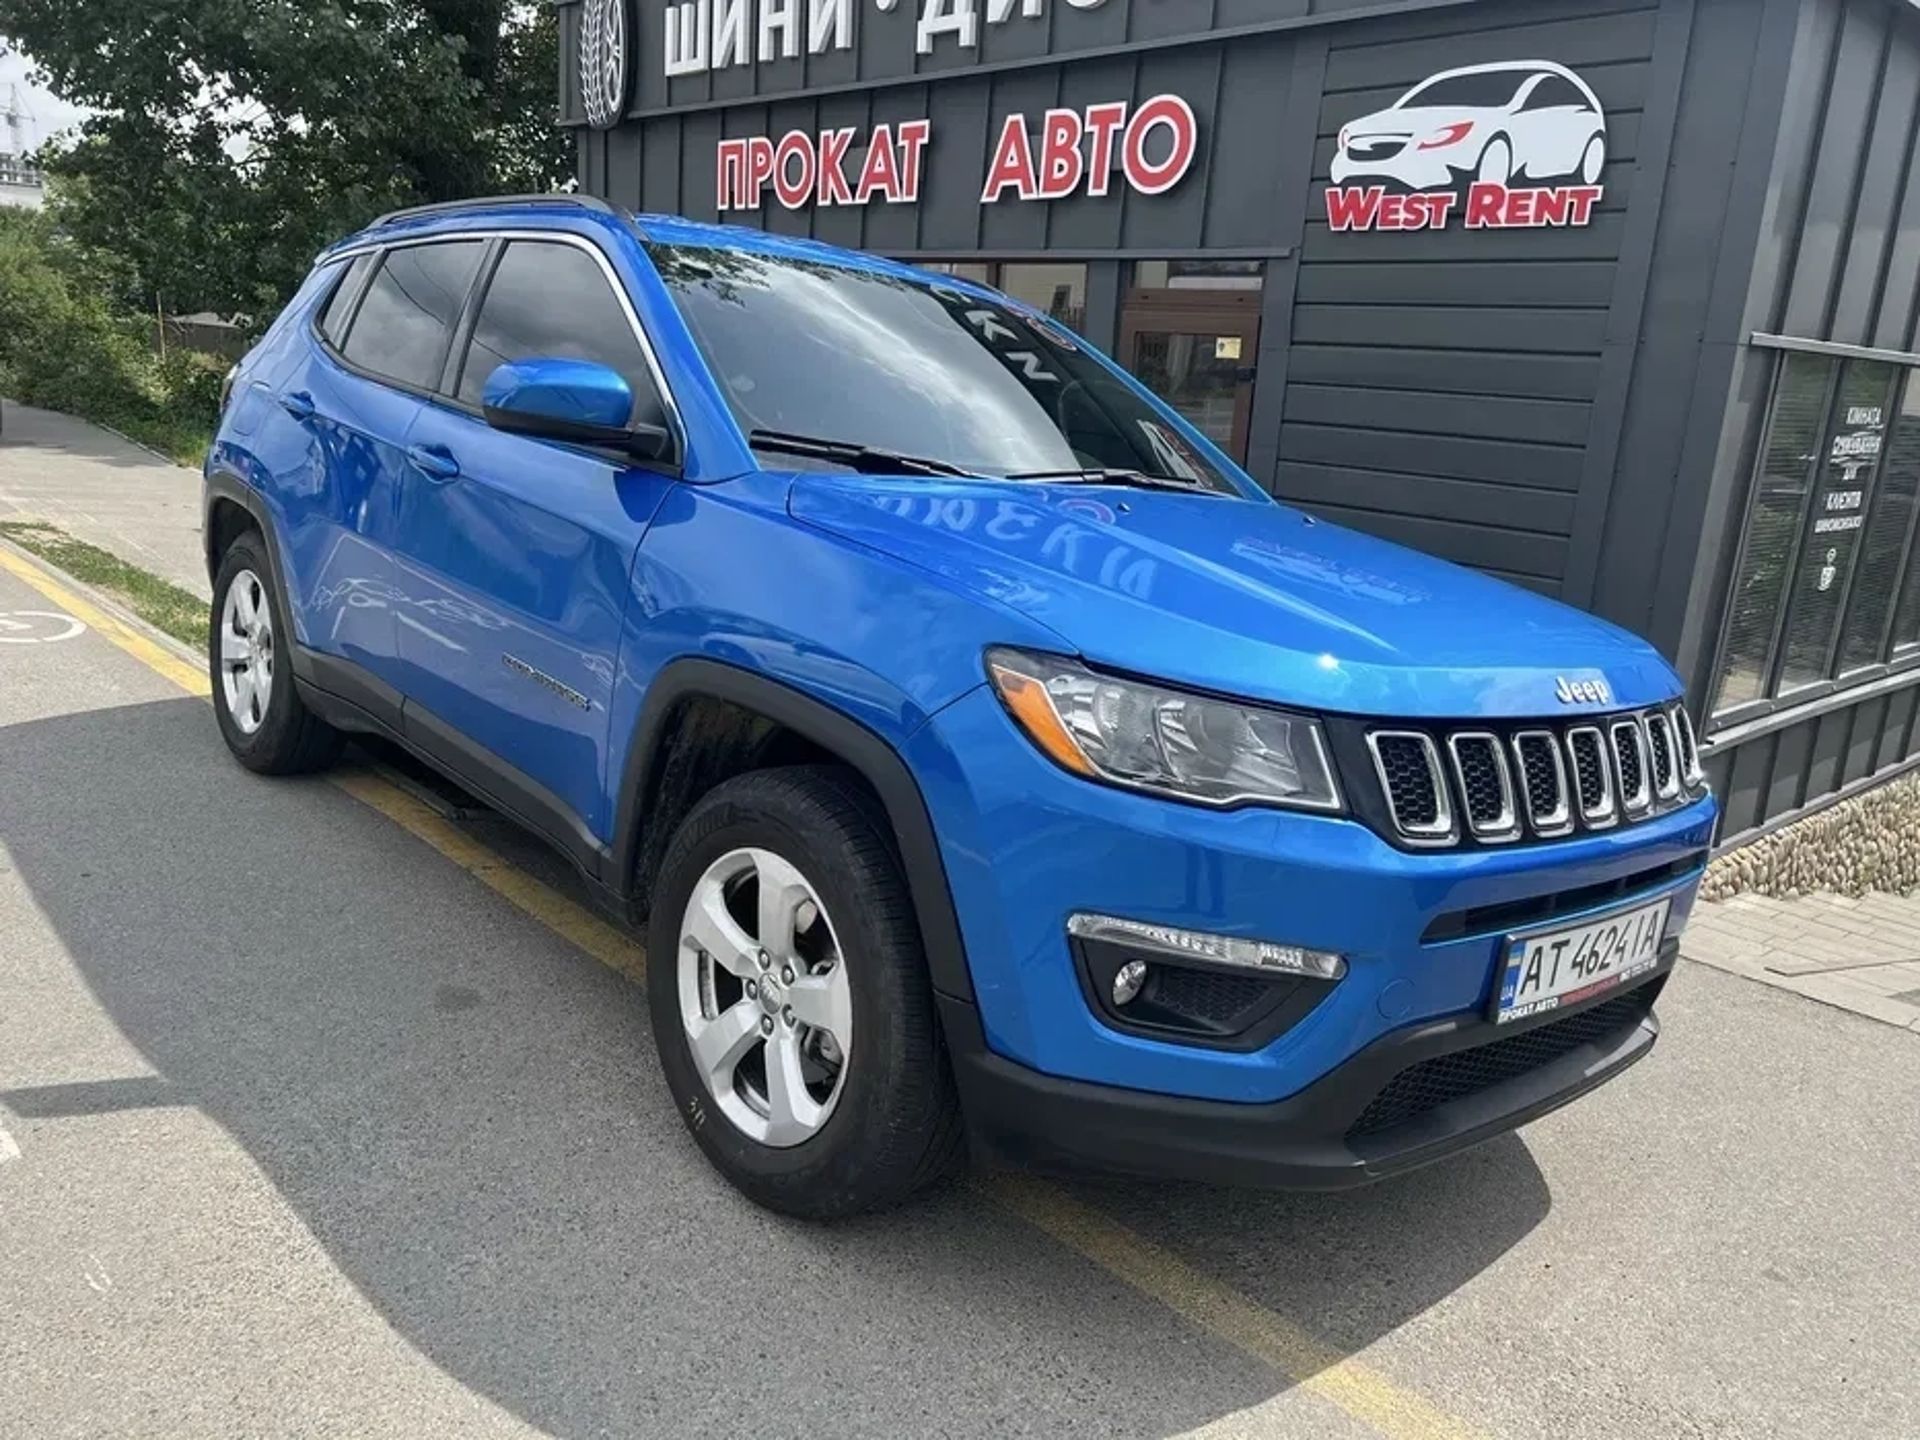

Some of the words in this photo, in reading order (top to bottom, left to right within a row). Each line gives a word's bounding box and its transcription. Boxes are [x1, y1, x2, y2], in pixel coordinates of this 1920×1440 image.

[664, 0, 853, 77] ШИНИ
[717, 118, 930, 211] ПРОКАТ
[980, 93, 1197, 203] АВТО
[1554, 675, 1609, 706] Jeep
[1571, 919, 1633, 980] 4624
